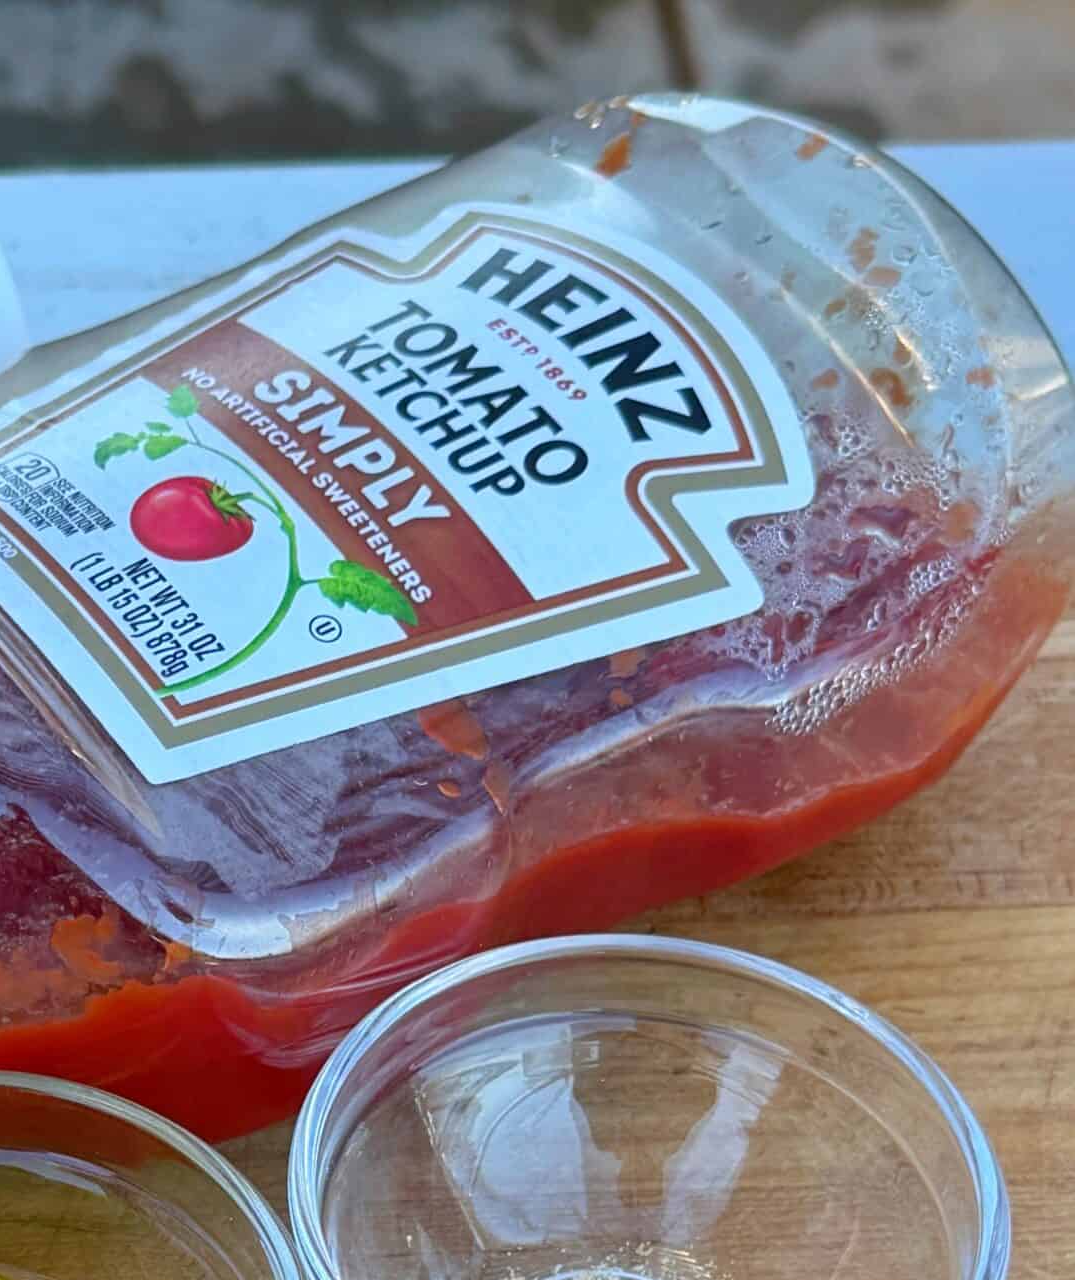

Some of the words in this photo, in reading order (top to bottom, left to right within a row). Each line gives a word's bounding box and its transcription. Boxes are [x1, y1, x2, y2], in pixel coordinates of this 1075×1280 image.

[458, 247, 713, 443] HEINZ
[365, 299, 590, 486] TOMATO
[541, 356, 589, 402] 1869
[324, 334, 526, 497] KETCHUP
[14, 458, 51, 481] 20
[254, 370, 453, 530] SIMPLY
[182, 367, 215, 389] NO
[209, 387, 316, 475] ARTIFICIAL
[312, 472, 433, 604] SWEETENERS
[11, 499, 51, 531] CONTENT
[25, 491, 47, 508] FOR
[40, 505, 78, 537] SODIUM
[39, 485, 97, 534] INFORMATION
[69, 491, 116, 531] NUTRITION
[70, 551, 105, 572] (1
[88, 566, 124, 592] LB
[107, 588, 140, 610] 15
[122, 557, 167, 590] NET
[149, 584, 190, 616] WT
[171, 612, 204, 636] 31
[188, 633, 226, 662] OZ
[122, 604, 164, 638] OZ)
[146, 631, 189, 678] 878g
